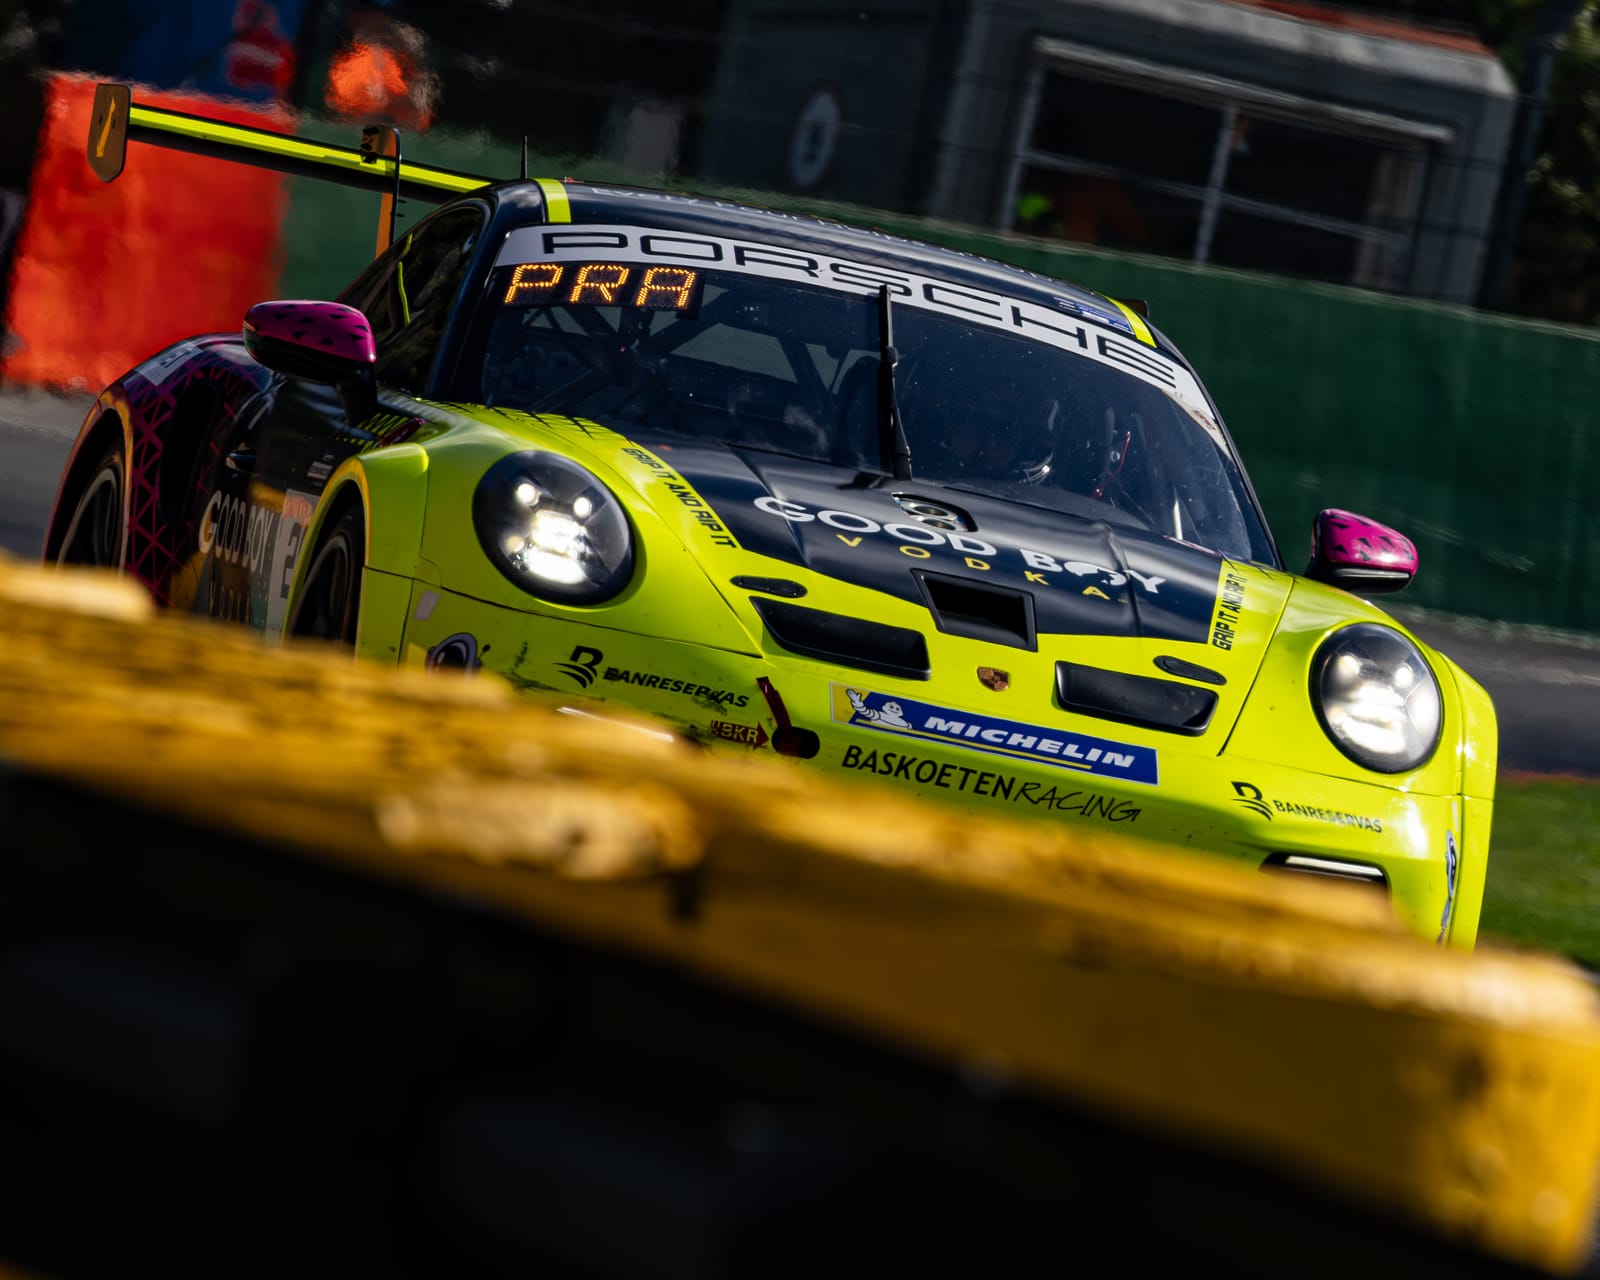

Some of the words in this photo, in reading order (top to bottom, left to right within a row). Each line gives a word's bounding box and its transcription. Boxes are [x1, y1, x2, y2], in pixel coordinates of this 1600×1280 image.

[504, 263, 696, 309] PRA
[542, 231, 1177, 389] PORSCHE
[621, 448, 664, 469] GRIP
[651, 470, 677, 481] IT
[664, 482, 703, 508] AND
[690, 510, 724, 532] RIP
[710, 535, 737, 549] IT
[198, 489, 247, 565] GOOD
[753, 496, 998, 556] GOOD
[1020, 548, 1167, 594] BOY
[835, 533, 1111, 601] VODKA
[1217, 610, 1239, 624] IT
[1220, 592, 1244, 614] AND
[1212, 621, 1236, 651] GRIP
[602, 667, 750, 708] BANRESERVAS
[924, 716, 1136, 768] MICHELIN
[1273, 799, 1383, 834] BANRESERVAS
